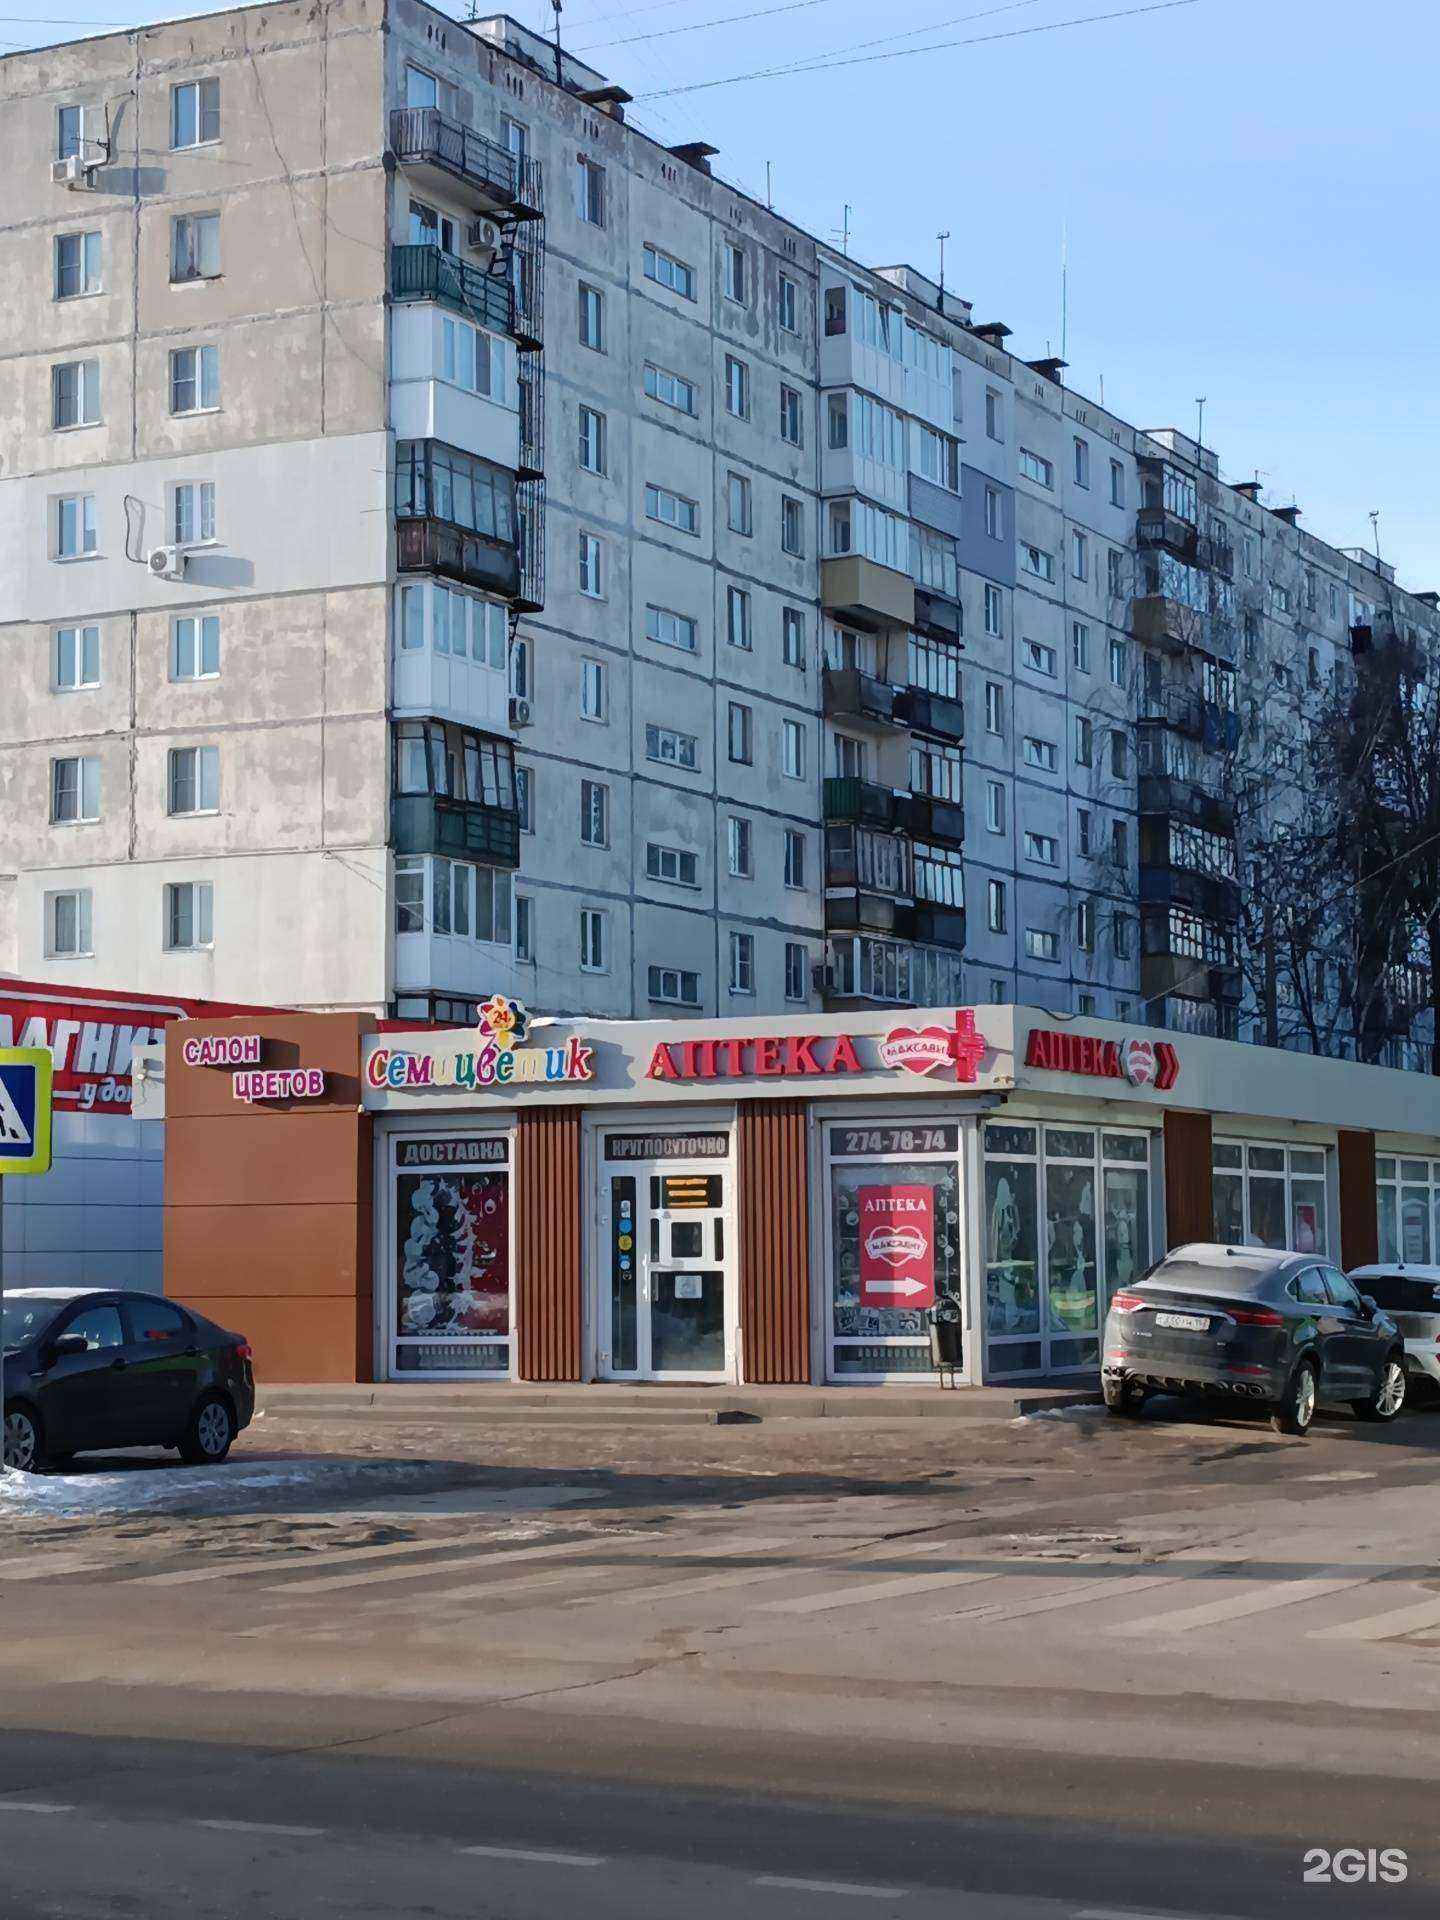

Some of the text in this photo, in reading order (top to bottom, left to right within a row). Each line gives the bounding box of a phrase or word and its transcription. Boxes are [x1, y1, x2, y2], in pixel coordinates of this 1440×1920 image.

[493, 1009, 511, 1024] 24
[0, 1014, 165, 1075] АГНИ
[183, 1036, 261, 1065] САЛОН
[645, 1034, 863, 1079] АПТЕКА
[1024, 1029, 1124, 1079] АПТЕКА
[233, 1070, 325, 1103] ЦВЕТОВ
[404, 1142, 505, 1164] ДОСТАВКА
[612, 1136, 726, 1156] КРУГЛОСУТОЧНО
[845, 1130, 946, 1152] 274-78-74
[865, 1199, 927, 1212] АПТЕКА
